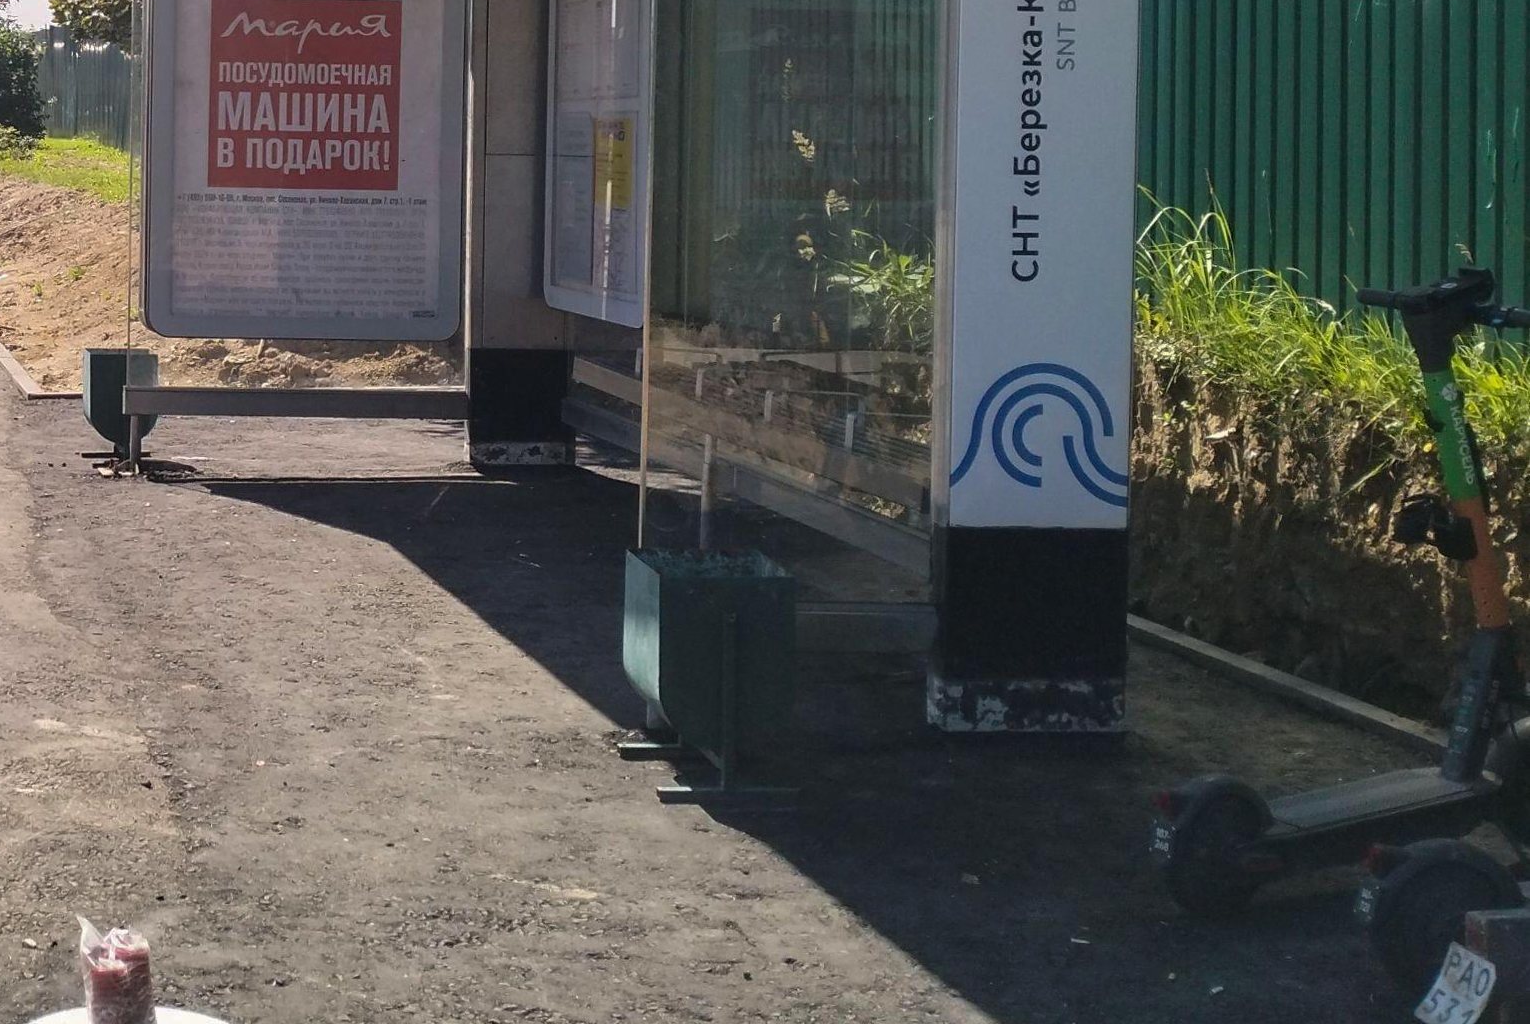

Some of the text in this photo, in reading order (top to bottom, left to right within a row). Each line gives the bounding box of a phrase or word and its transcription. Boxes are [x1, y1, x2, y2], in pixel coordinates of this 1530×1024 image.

[1056, 22, 1076, 71] SNT
[218, 61, 392, 87] ПОСУДОМОЕЧНАЯ
[218, 91, 390, 133] МАШИНА
[217, 137, 390, 175] В ПОДАРОК!
[1012, 205, 1039, 283] СНТ
